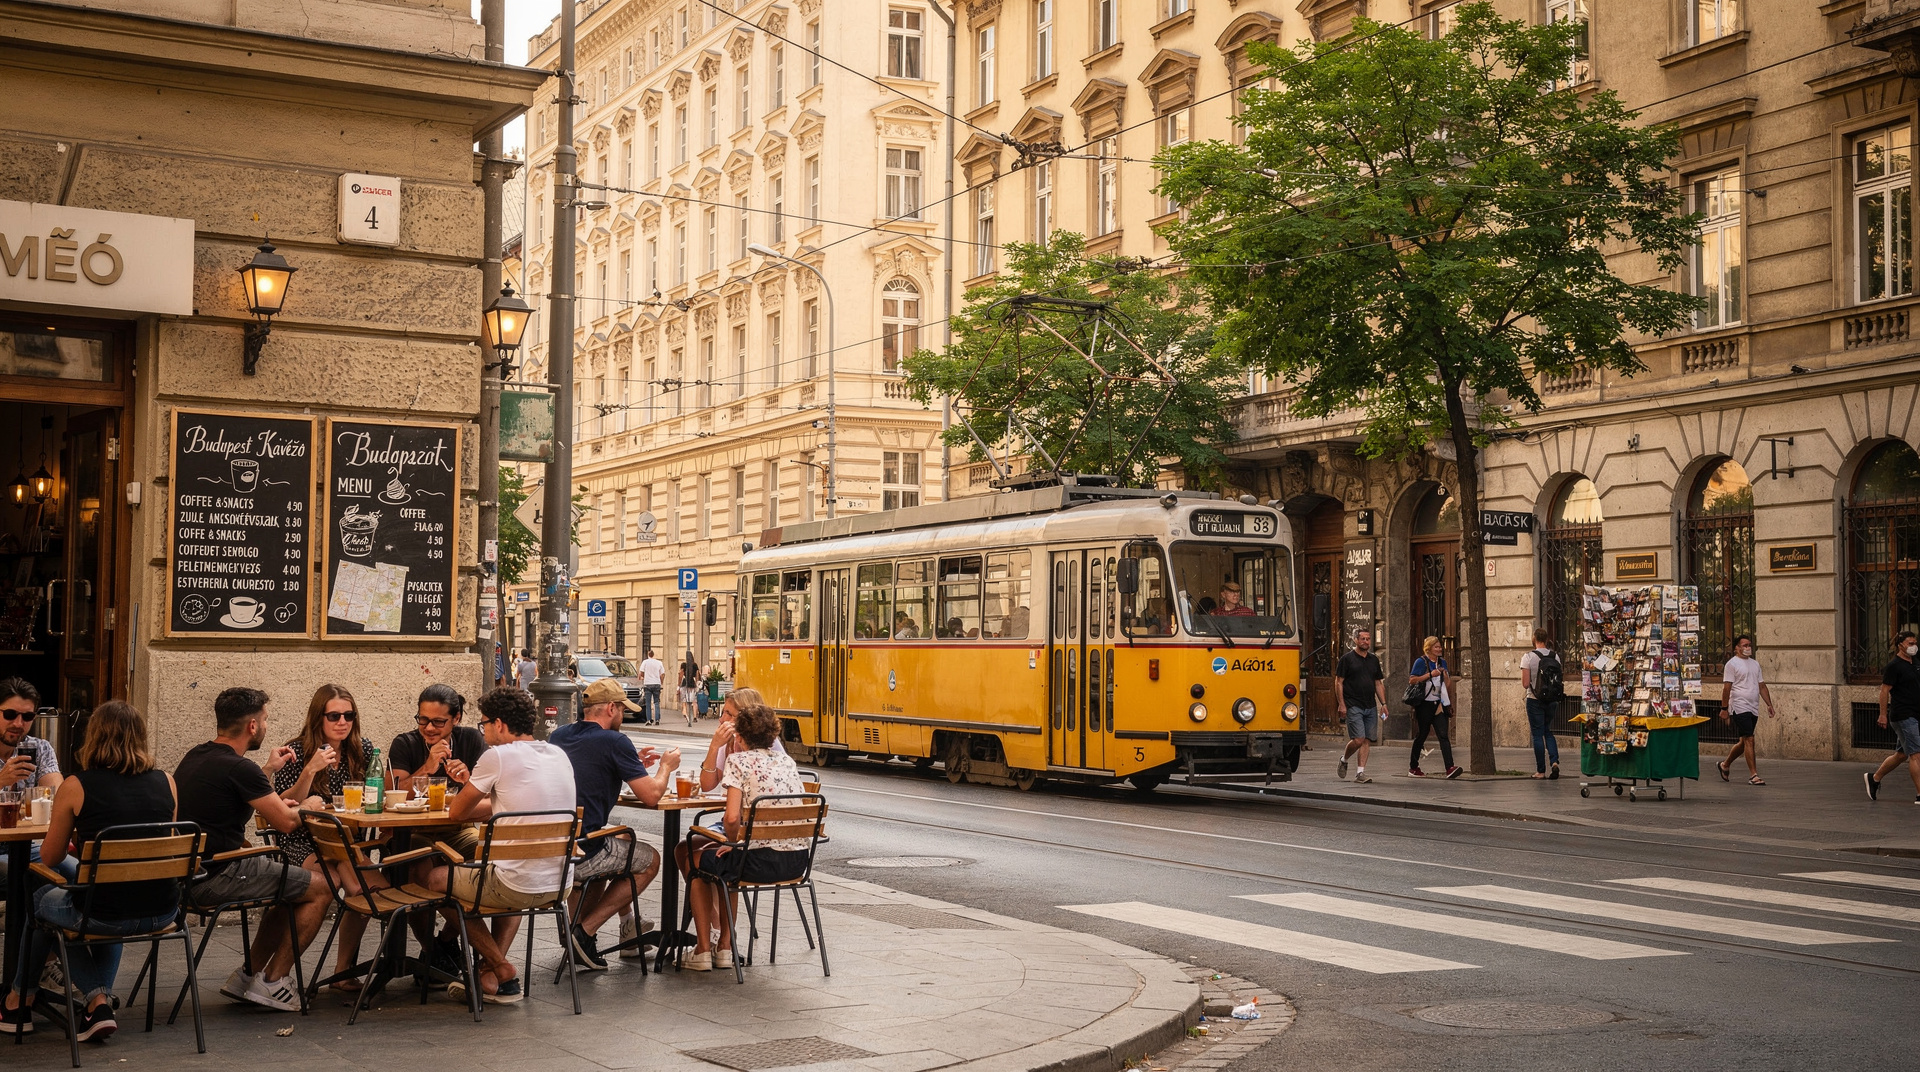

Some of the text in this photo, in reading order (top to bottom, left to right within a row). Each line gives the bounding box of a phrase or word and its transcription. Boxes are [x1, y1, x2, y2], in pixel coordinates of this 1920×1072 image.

[364, 206, 379, 230] 4
[338, 476, 373, 494] MENU
[180, 494, 213, 507] COFFEE
[399, 507, 427, 519] COFFEE
[178, 527, 206, 540] COFFE
[682, 570, 695, 588] P
[1133, 746, 1145, 763] 5
